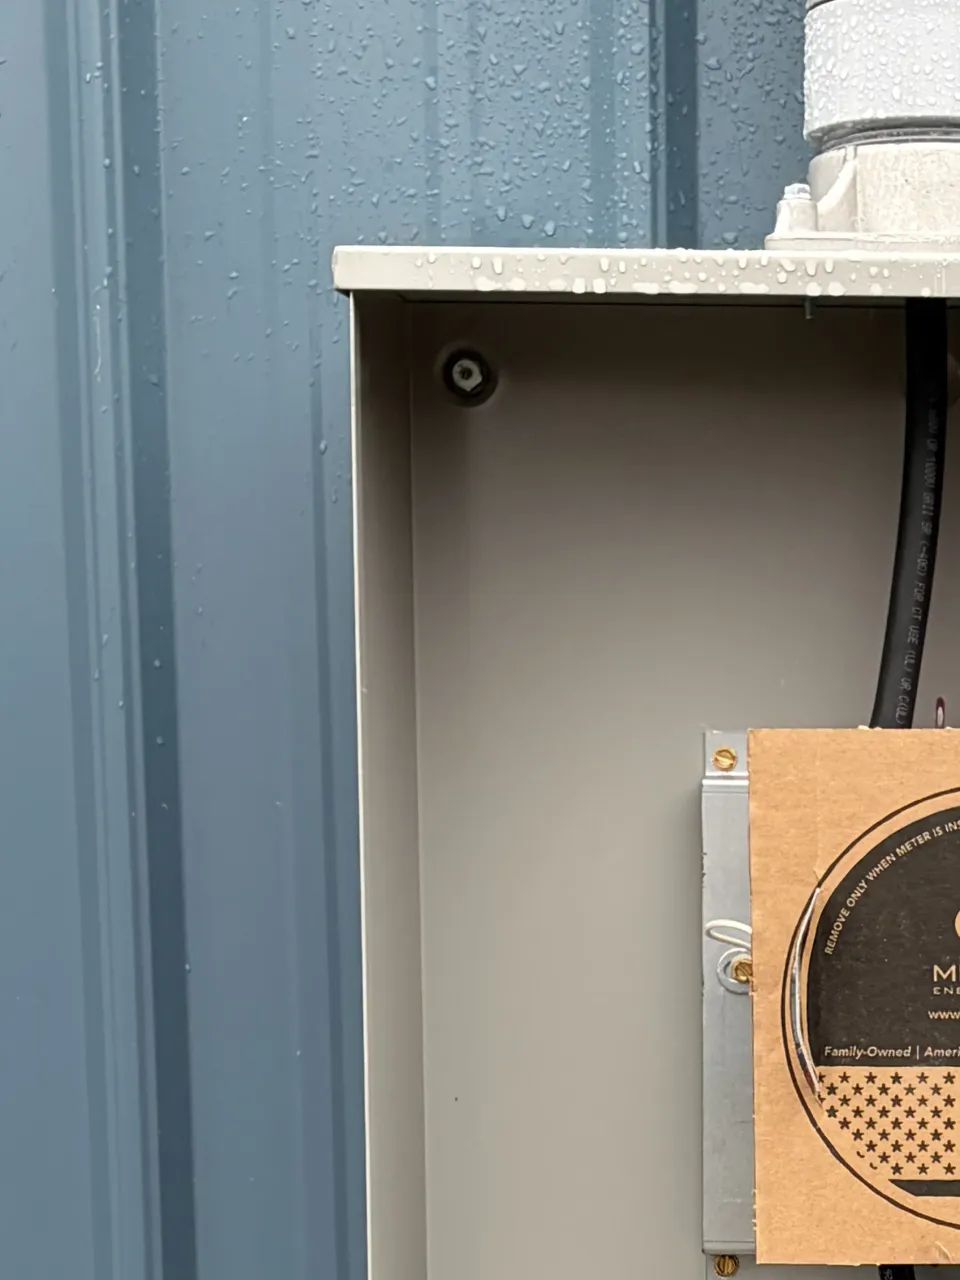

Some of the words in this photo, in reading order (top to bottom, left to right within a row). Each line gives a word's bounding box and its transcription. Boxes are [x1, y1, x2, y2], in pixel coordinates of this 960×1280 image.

[824, 907, 851, 955] REMOVE
[845, 879, 869, 908] ONLY
[865, 852, 897, 882] WHEN
[895, 830, 932, 857] METER
[932, 825, 944, 838] IS
[823, 1045, 912, 1060] Family-Owned
